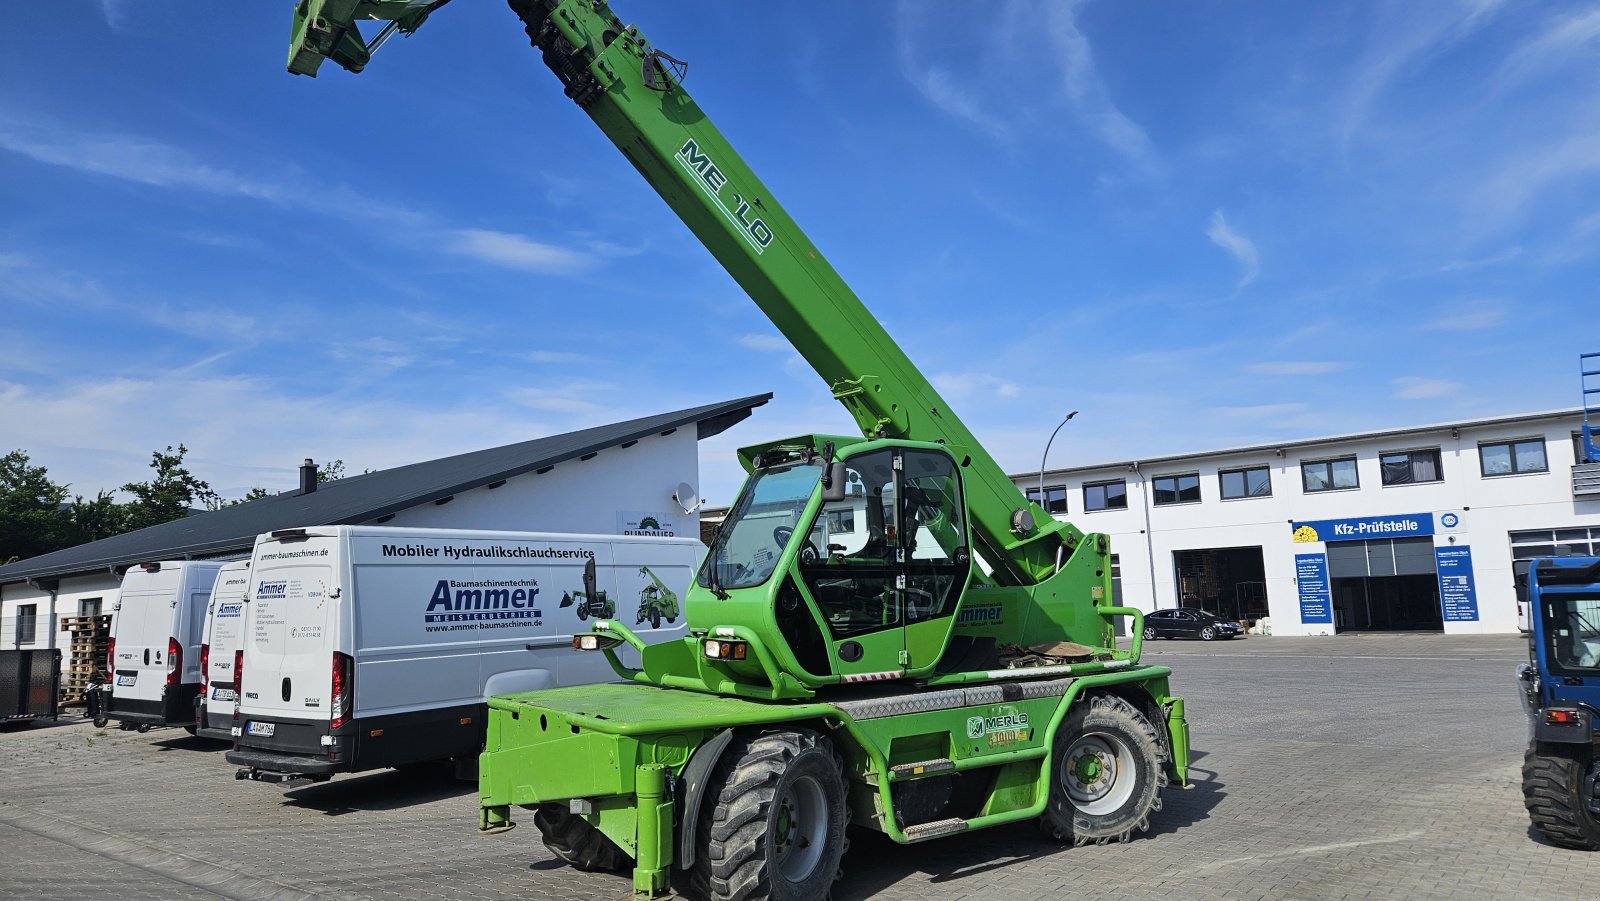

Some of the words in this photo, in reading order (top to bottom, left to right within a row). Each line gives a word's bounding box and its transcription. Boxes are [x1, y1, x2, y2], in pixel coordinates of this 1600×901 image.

[680, 138, 773, 247] MELO
[1334, 520, 1418, 535] Kfz-Prüfstelle
[260, 548, 329, 561] ammer-baumaschinen.de
[382, 544, 439, 557] Mobiler
[443, 545, 595, 560] Hydraulikschlauchservice
[257, 581, 287, 595] Ammer
[450, 579, 538, 588] Baumaschinentechnik
[425, 580, 540, 612] Ammer
[218, 603, 242, 614] Ammer
[957, 607, 1003, 623] mmer
[433, 611, 536, 622] MEISTERBETRIEB
[425, 620, 543, 633] www.ammer-baumaschinen.de
[985, 713, 1028, 730] MERLO
